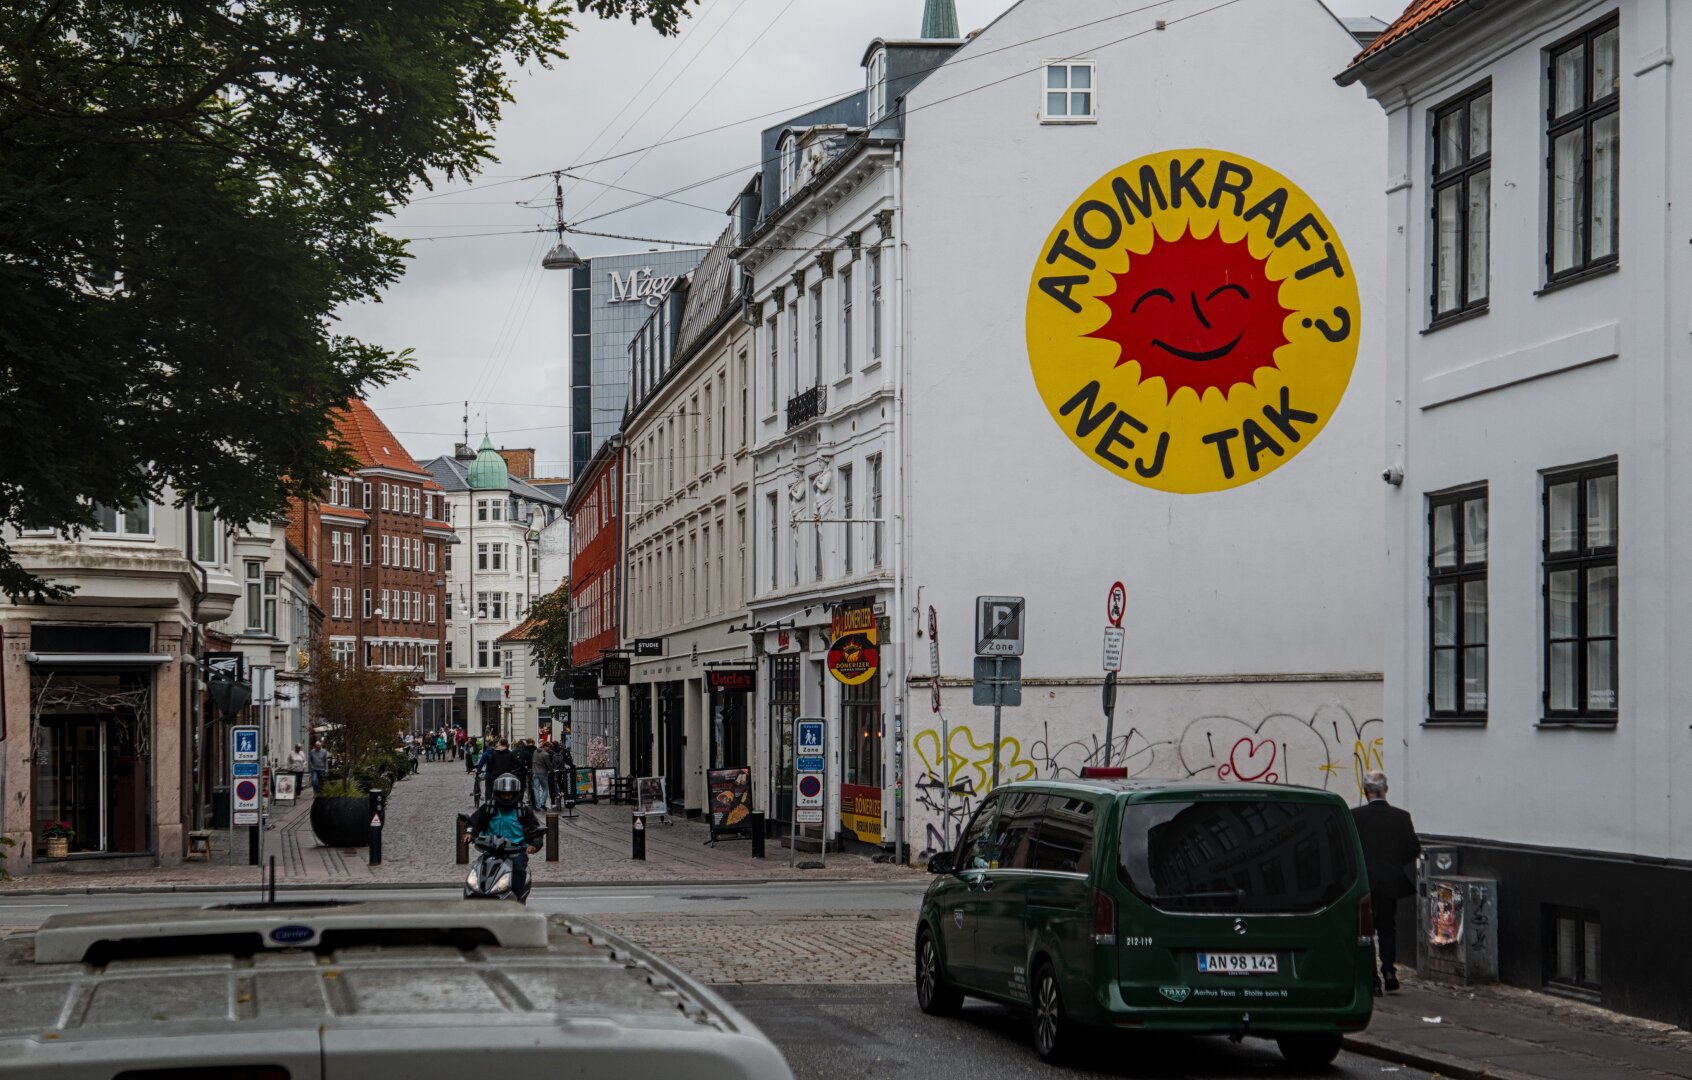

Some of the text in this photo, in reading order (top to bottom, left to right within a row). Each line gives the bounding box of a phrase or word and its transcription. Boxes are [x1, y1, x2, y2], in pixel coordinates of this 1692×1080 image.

[1038, 158, 1344, 313] ATOMKRAFT
[1059, 380, 1318, 479] NEJ TAK
[989, 642, 1013, 650] Zone
[711, 671, 751, 685] Uncle's
[275, 928, 309, 939] Carrier
[1126, 937, 1153, 946] 212-119
[1209, 954, 1276, 969] AN 98 142
[1194, 989, 1218, 997] Aarhus
[1220, 989, 1236, 997] Taxa
